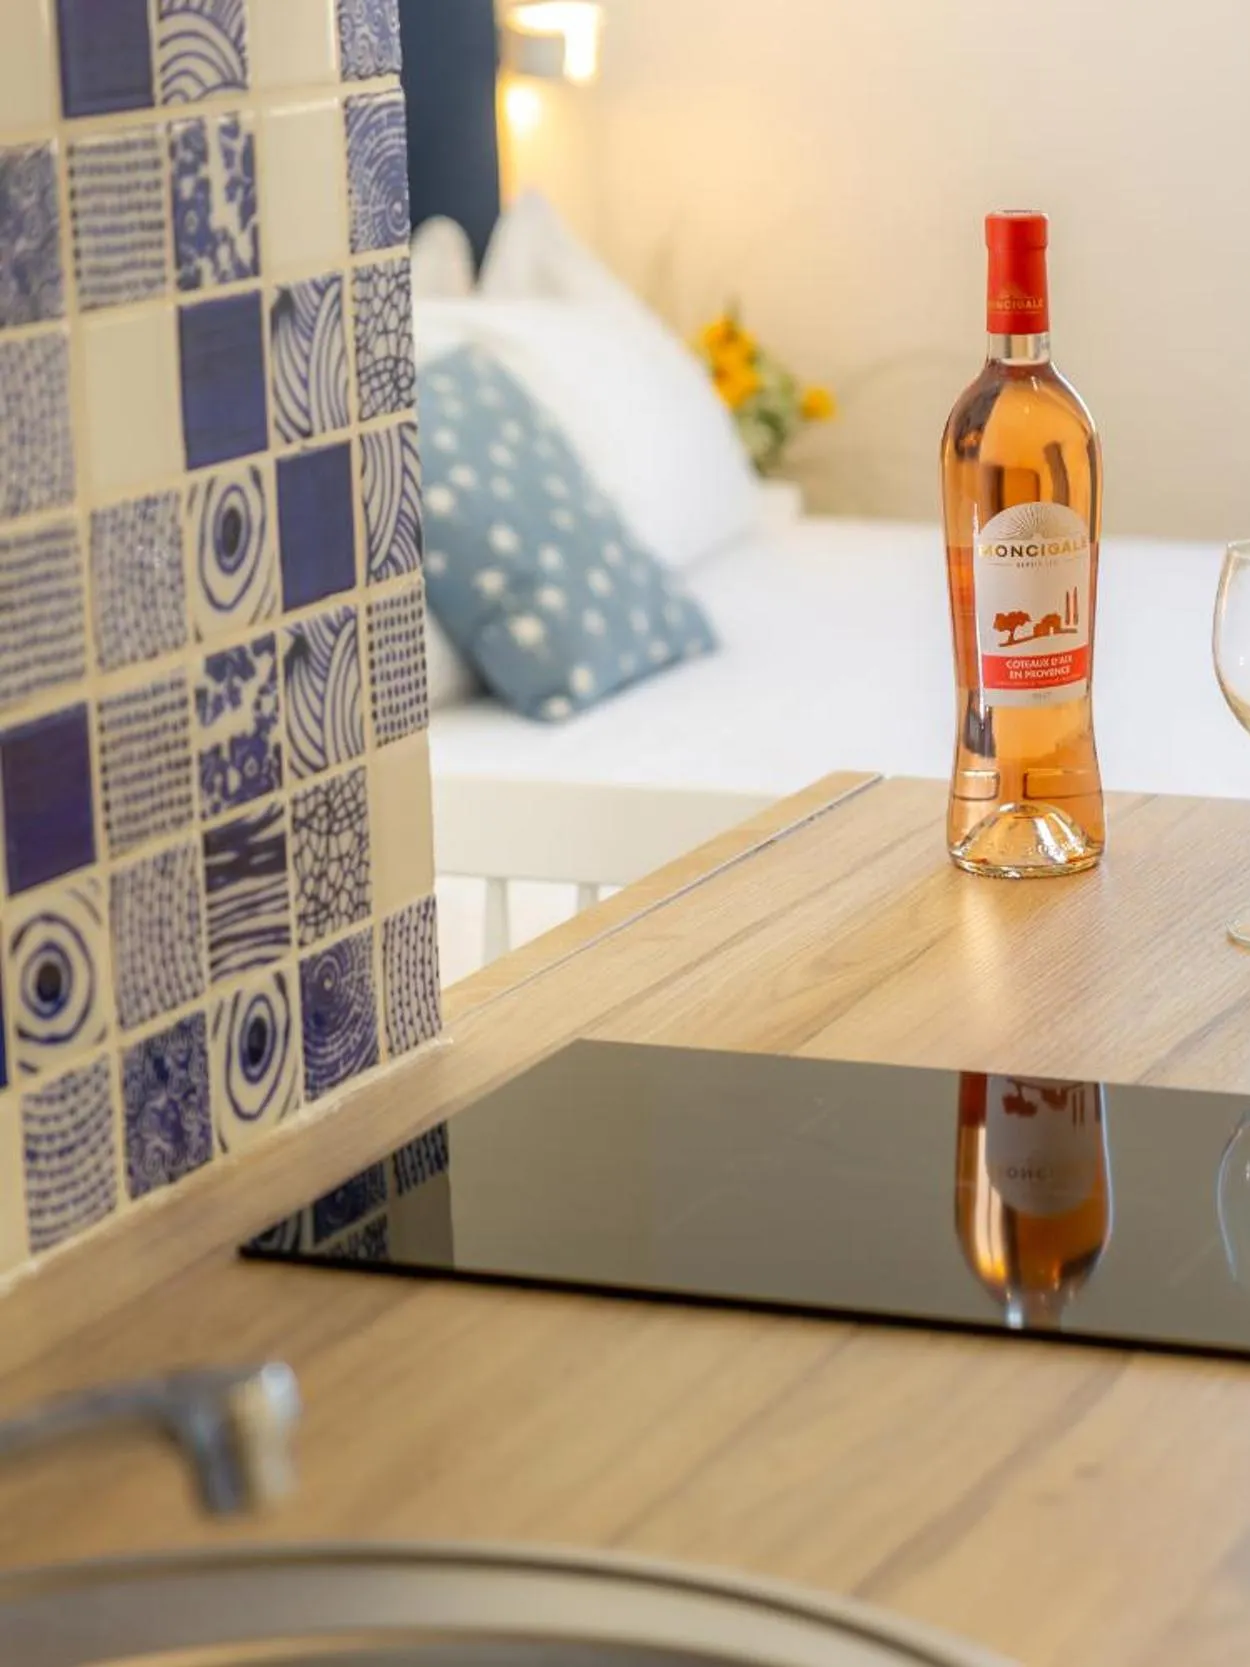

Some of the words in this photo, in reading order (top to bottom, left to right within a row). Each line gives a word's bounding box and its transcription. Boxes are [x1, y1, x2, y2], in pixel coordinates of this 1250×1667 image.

[1006, 658, 1049, 669] COTEAUX
[1050, 655, 1073, 666] D'AIX
[1009, 670, 1022, 679] EN
[1024, 666, 1070, 679] PROVENCE
